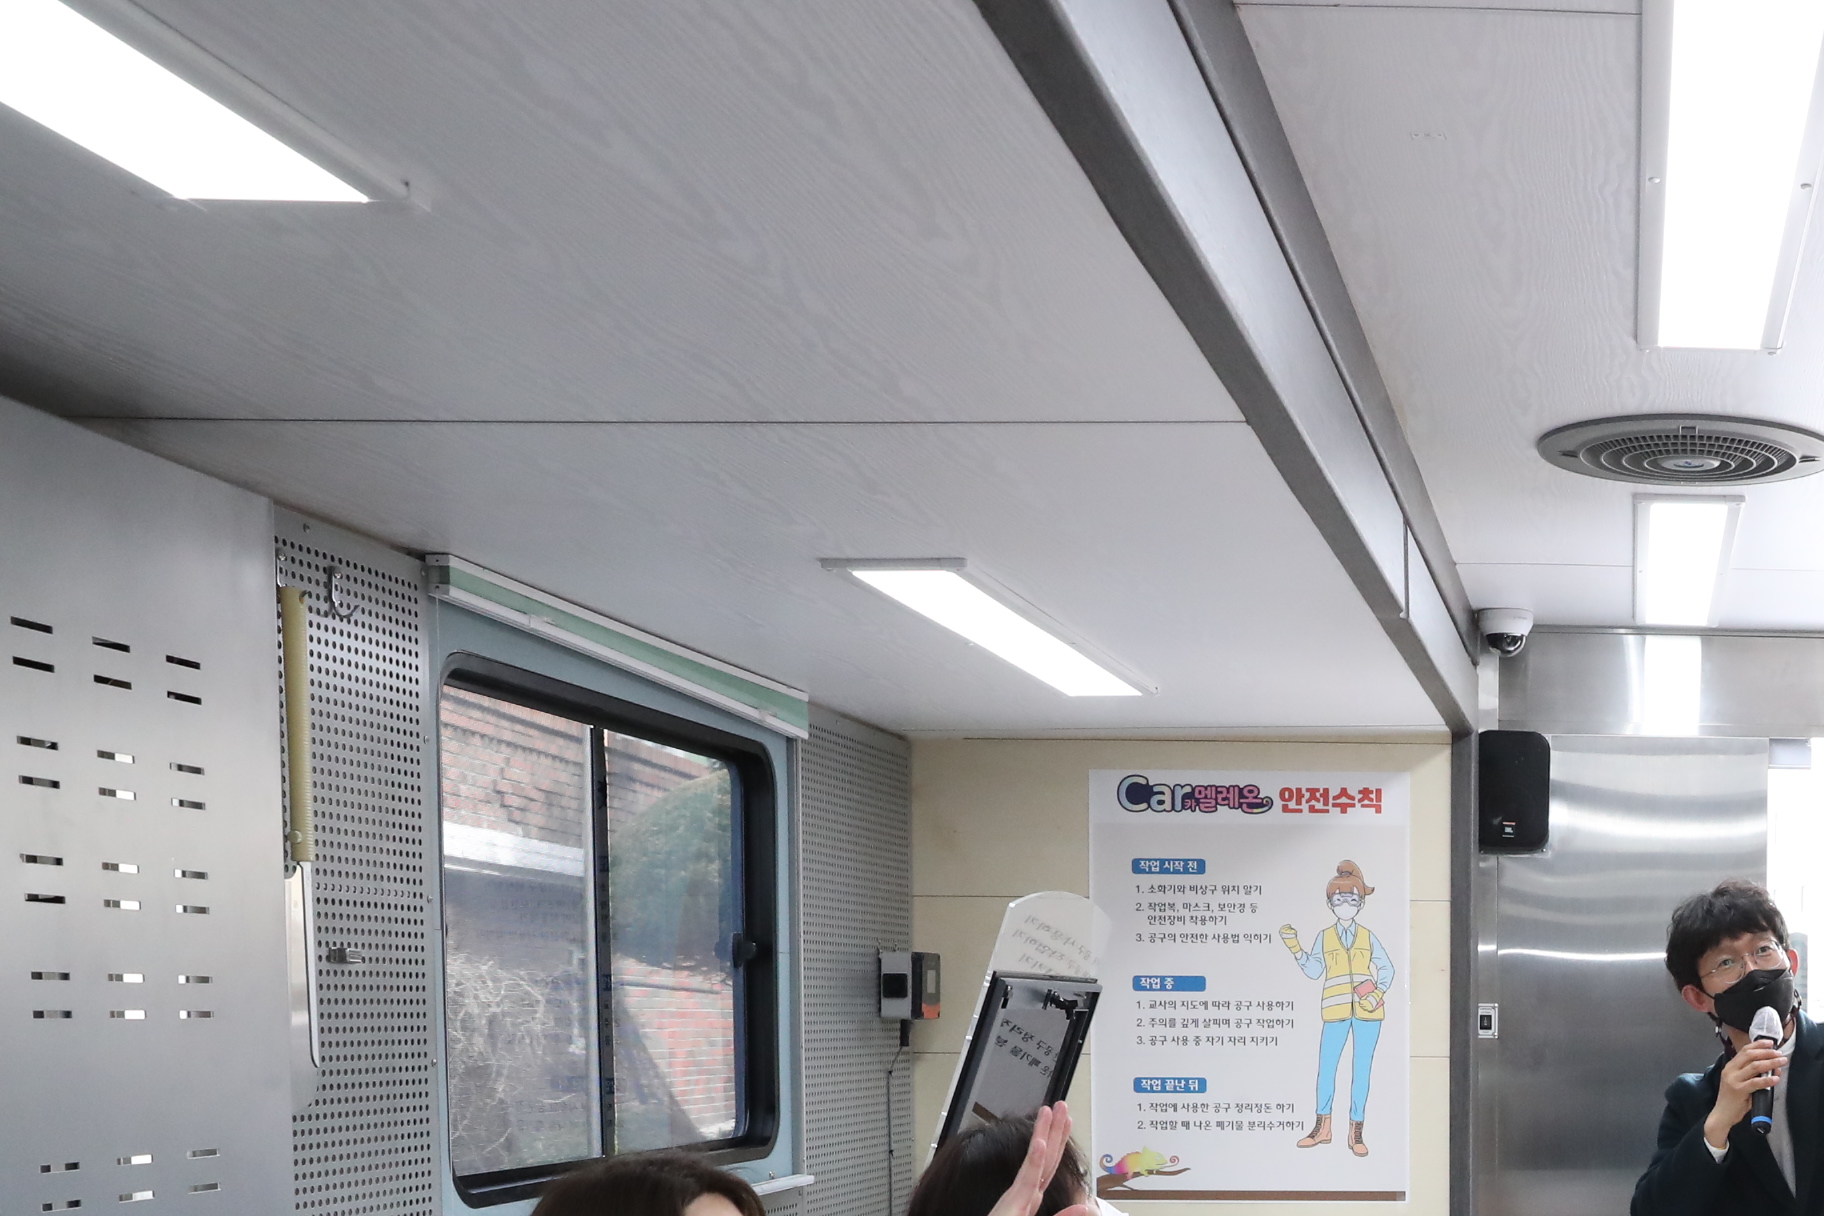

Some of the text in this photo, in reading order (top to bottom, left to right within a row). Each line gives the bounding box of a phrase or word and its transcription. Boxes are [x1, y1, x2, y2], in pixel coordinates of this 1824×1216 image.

[1279, 787, 1382, 814] 안전수칙
[1139, 860, 1197, 872] 작업 시작 전
[1135, 884, 1262, 895] 1. 소화기와 비상구 위치 알기
[1135, 902, 1259, 913] 2. 작업복, 마스크, 보안경 등
[1147, 915, 1227, 926] 안전장비 착용하기
[1135, 933, 1272, 944] 3. 공구의 안전한 사용법 익히기
[1139, 977, 1175, 989] 작업 중
[1136, 1000, 1294, 1011] 1. 교사의 지도에 따라 공구 사용하기
[1136, 1018, 1294, 1029] 2. 주의를 깊게 살피며 공구 작업하기
[1136, 1036, 1278, 1046] 3. 공구 사용 중 자기 자리 지키기
[1140, 1079, 1199, 1091] 작업 끝난 뒤
[1137, 1103, 1295, 1113] 1. 작업에 사용한 공구 정리정돈 하기
[1137, 1120, 1305, 1131] 2. 작업할 때 나온 폐기물 분리수거하기
